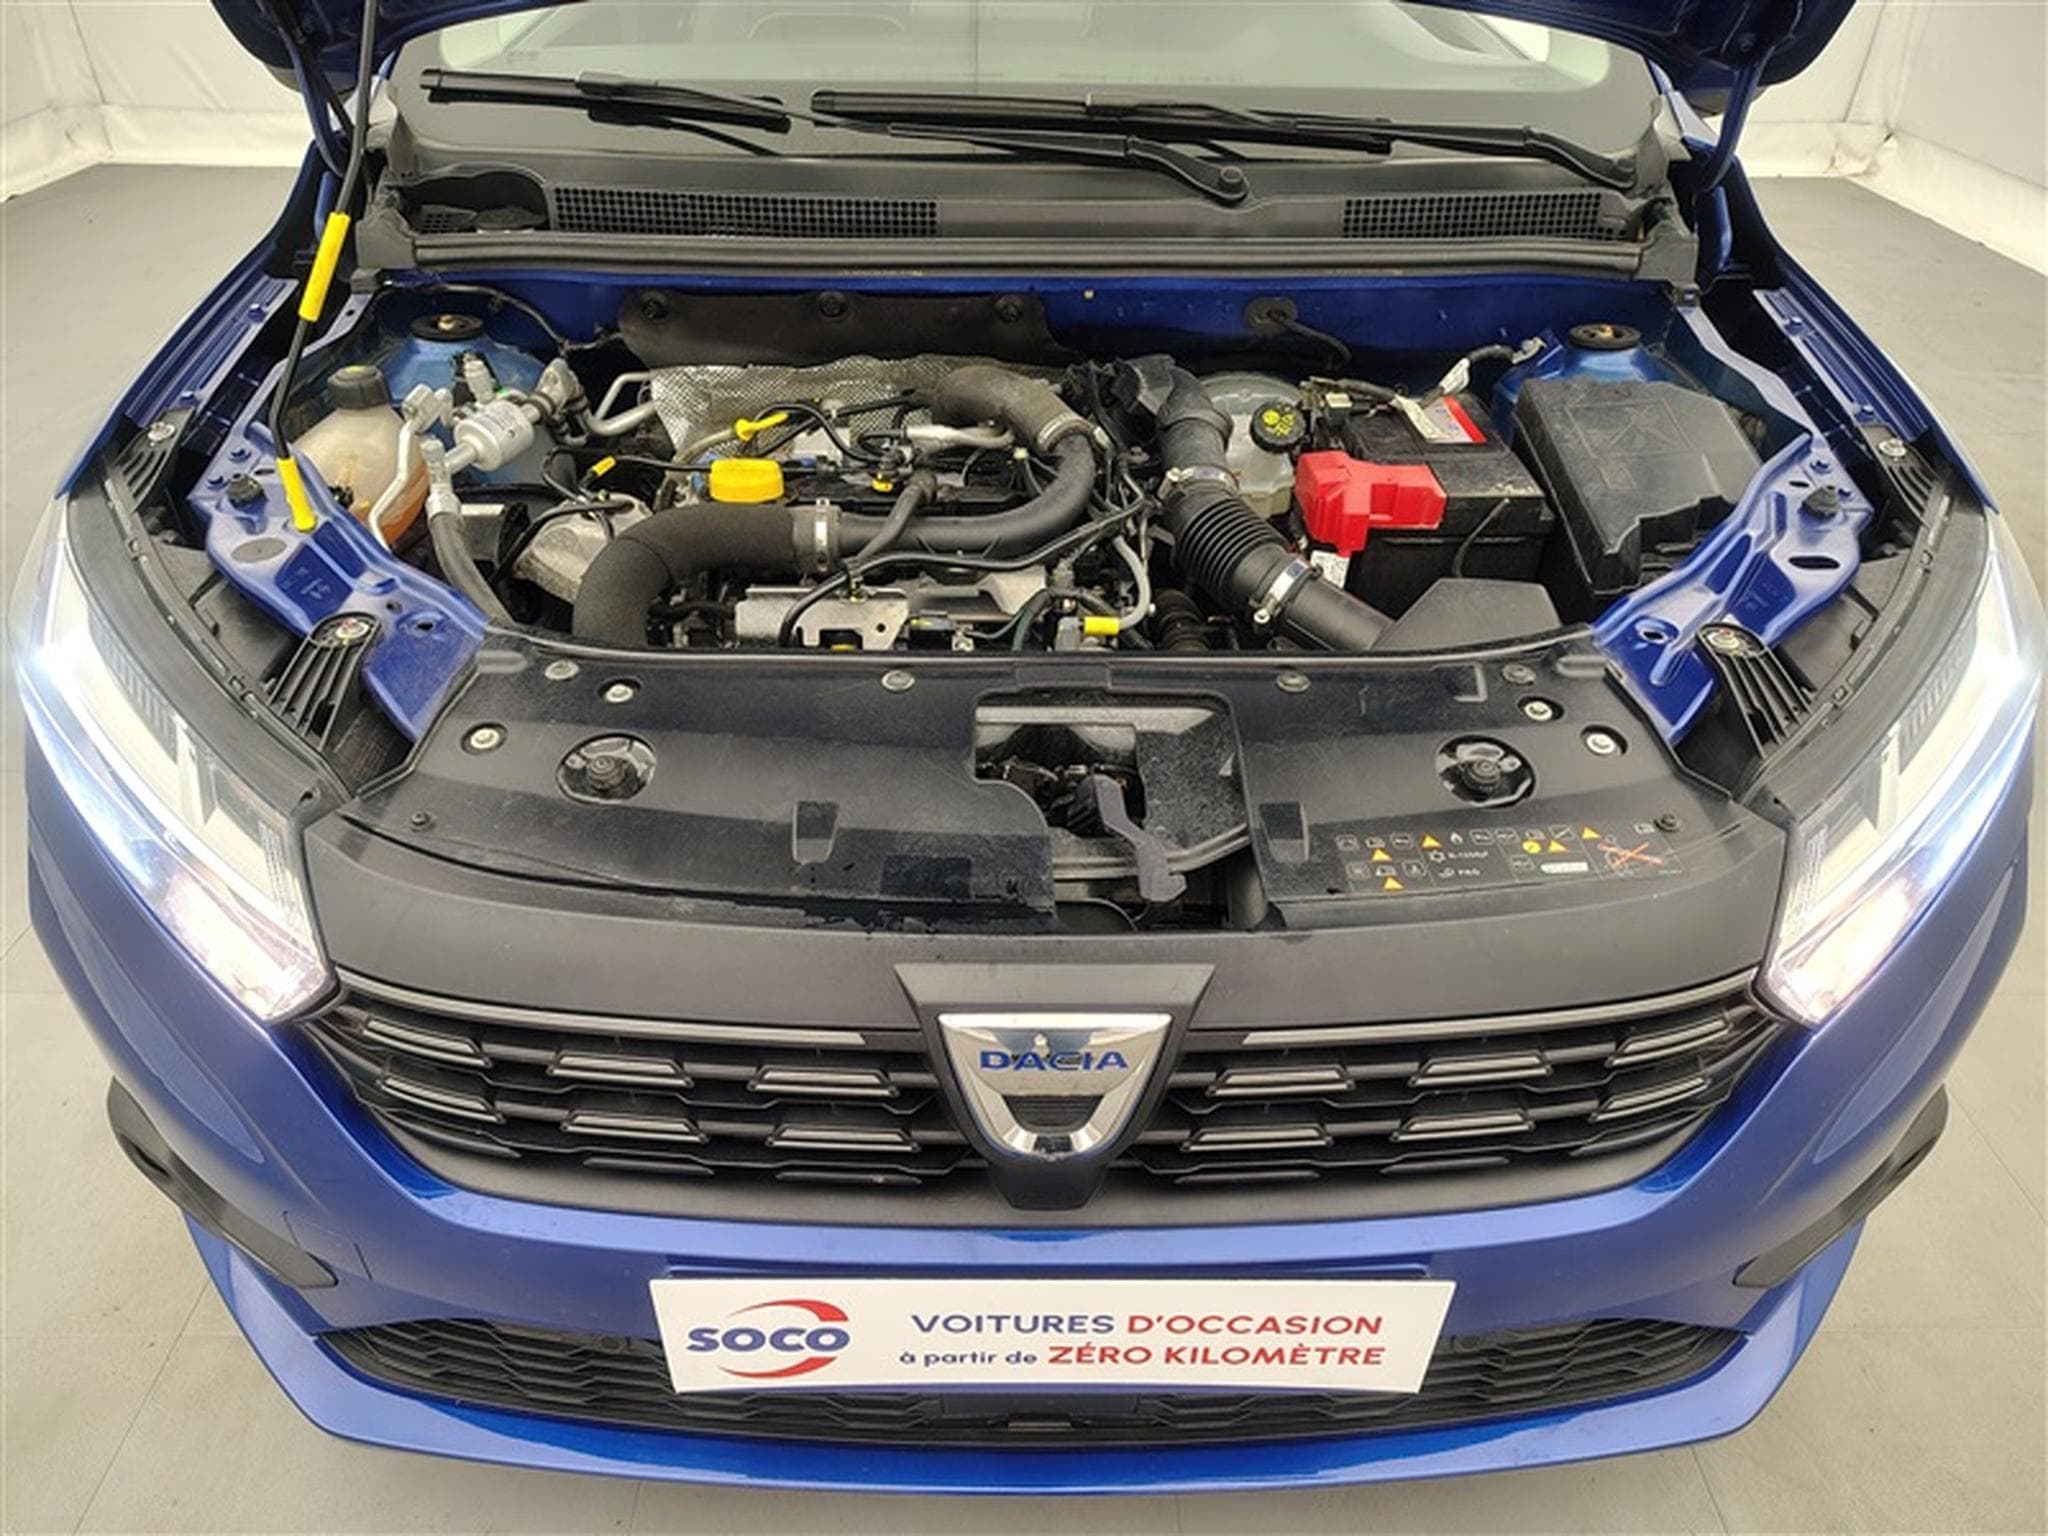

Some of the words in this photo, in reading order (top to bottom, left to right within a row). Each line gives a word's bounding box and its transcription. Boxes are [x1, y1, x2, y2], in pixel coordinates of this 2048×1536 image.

[980, 1050, 1128, 1071] DACIA
[911, 1314, 1115, 1334] VOITURES
[1127, 1315, 1383, 1335] D'OCCASION
[686, 1327, 850, 1352] SOCO
[899, 1350, 916, 1364] à
[923, 1351, 998, 1367] partir
[1005, 1350, 1037, 1365] de
[1048, 1342, 1152, 1365] ZÉRO
[1164, 1343, 1386, 1366] KILOMÈTRE
